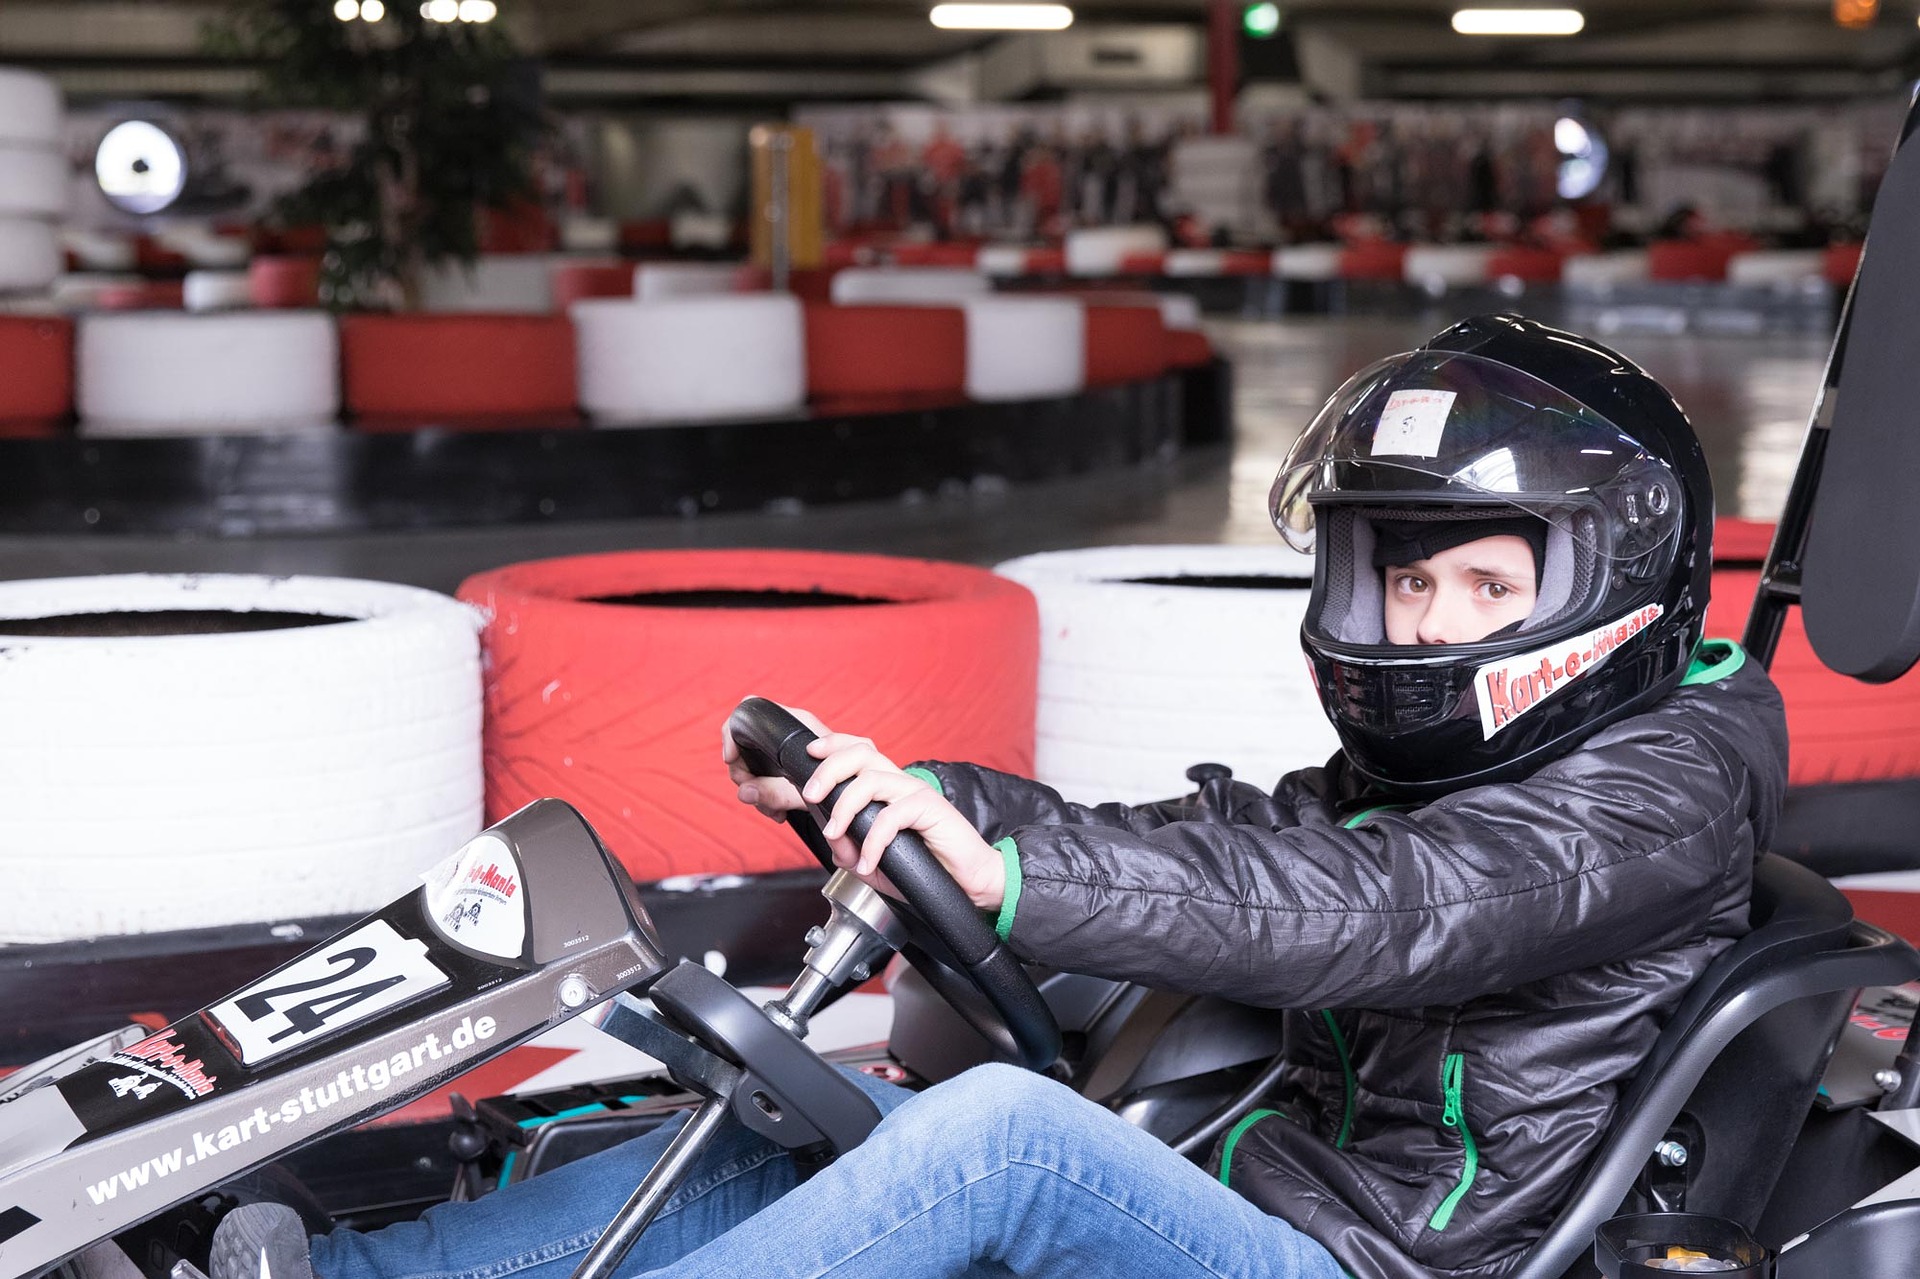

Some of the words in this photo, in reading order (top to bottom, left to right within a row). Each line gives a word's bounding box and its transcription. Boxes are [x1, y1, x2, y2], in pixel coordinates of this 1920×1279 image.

[234, 946, 407, 1044] 24
[616, 963, 642, 981] 3003512
[86, 1013, 498, 1205] www.kart-stuttgart.de
